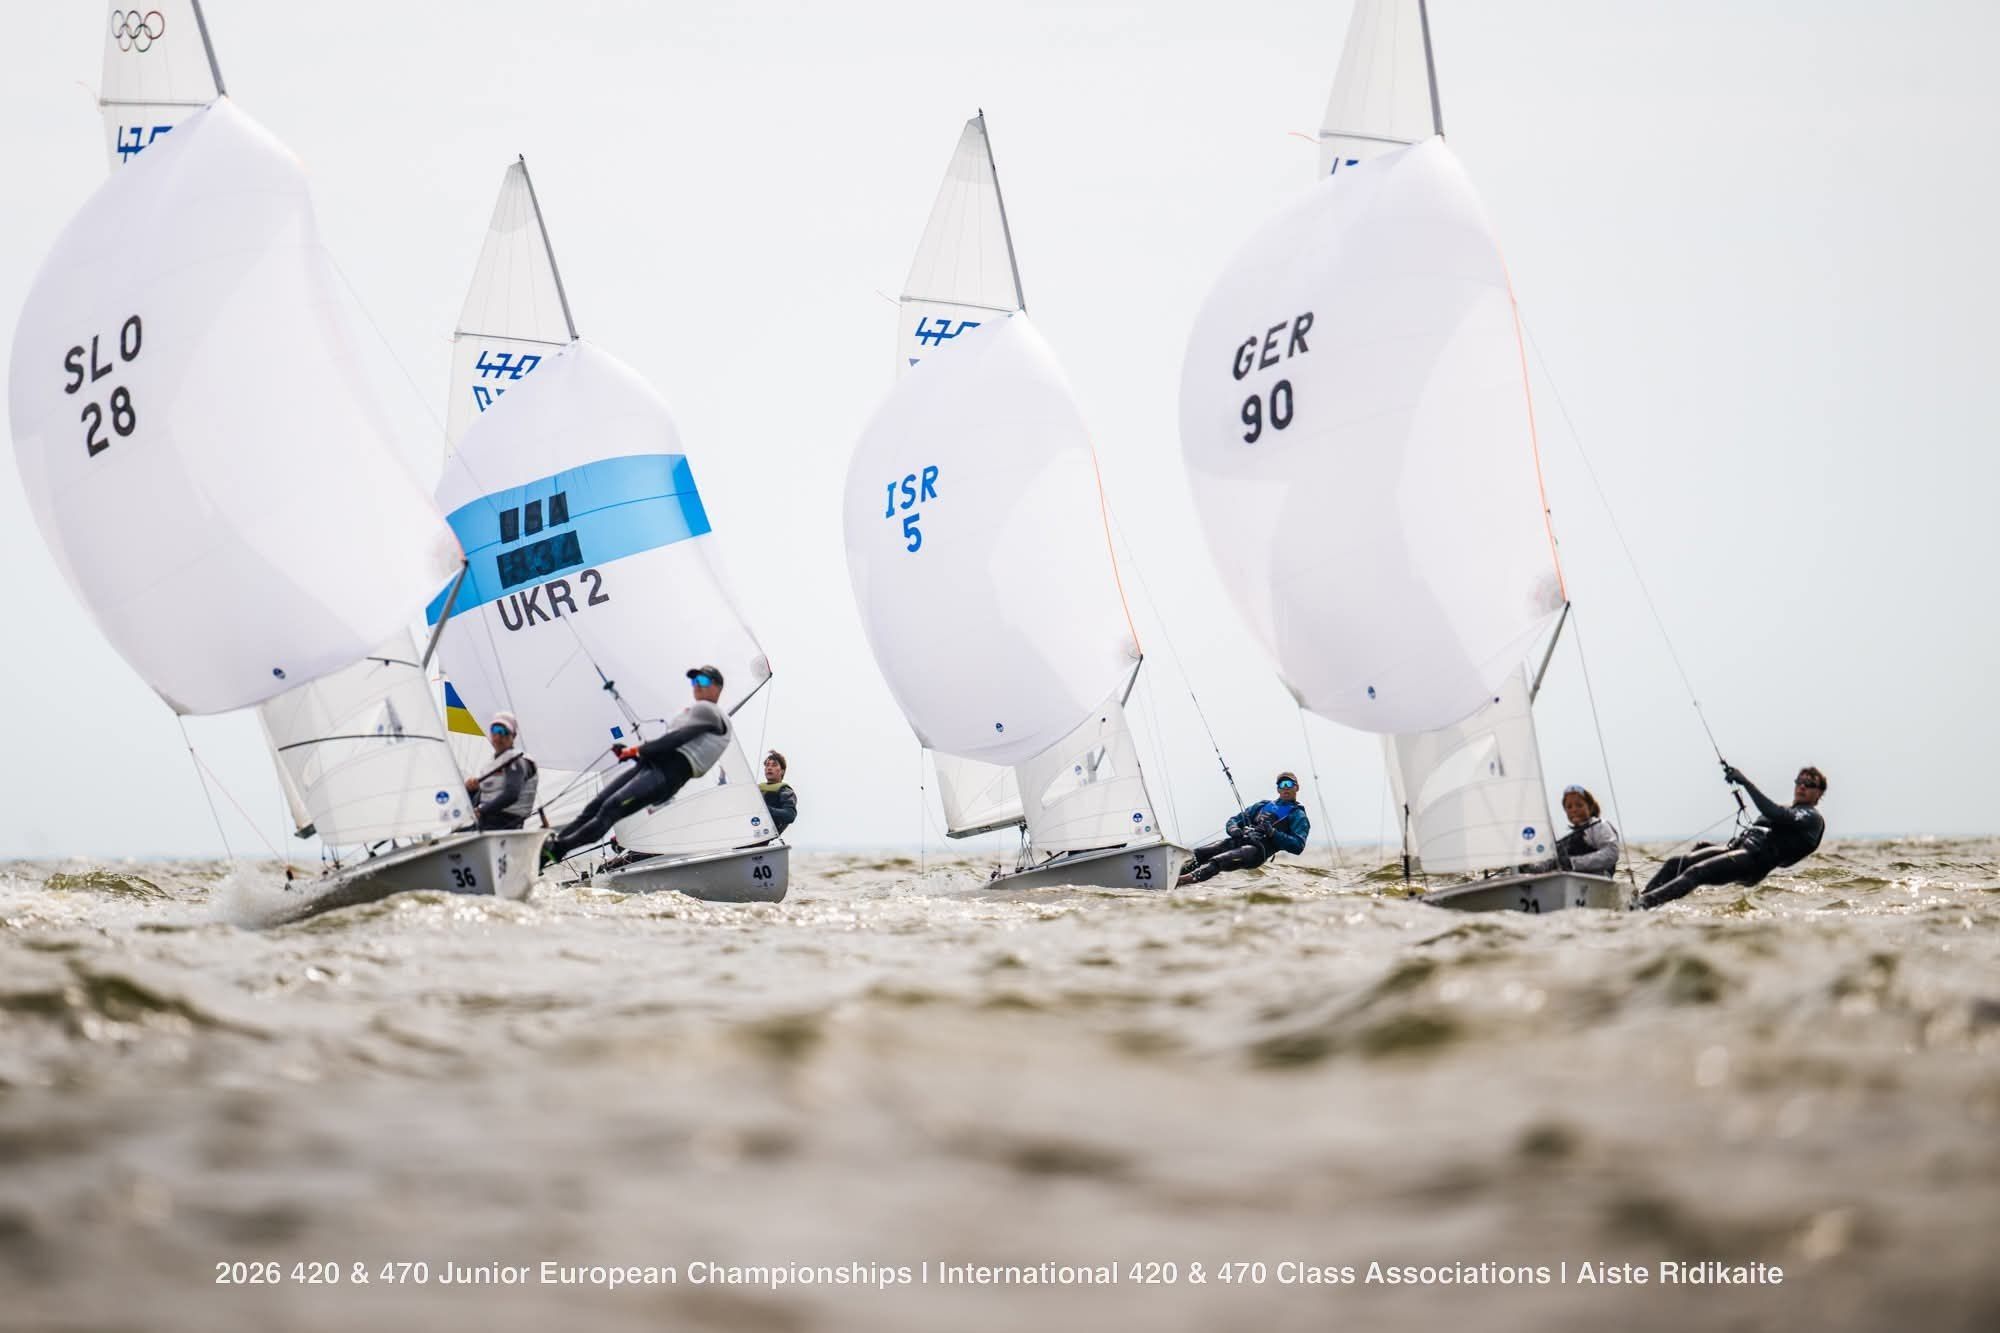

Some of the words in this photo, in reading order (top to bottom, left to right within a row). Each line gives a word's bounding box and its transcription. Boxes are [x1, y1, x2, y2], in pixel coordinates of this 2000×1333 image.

[64, 315, 142, 394] SLO
[476, 351, 542, 380] 470
[1233, 312, 1314, 380] GER
[81, 386, 136, 457] 28
[1241, 380, 1294, 443] 90
[886, 465, 939, 519] ISR
[903, 513, 922, 553] 5
[497, 579, 579, 632] UKR
[580, 569, 609, 607] 2
[451, 867, 476, 888] 36
[753, 865, 772, 880] 40
[1133, 865, 1152, 880] 25
